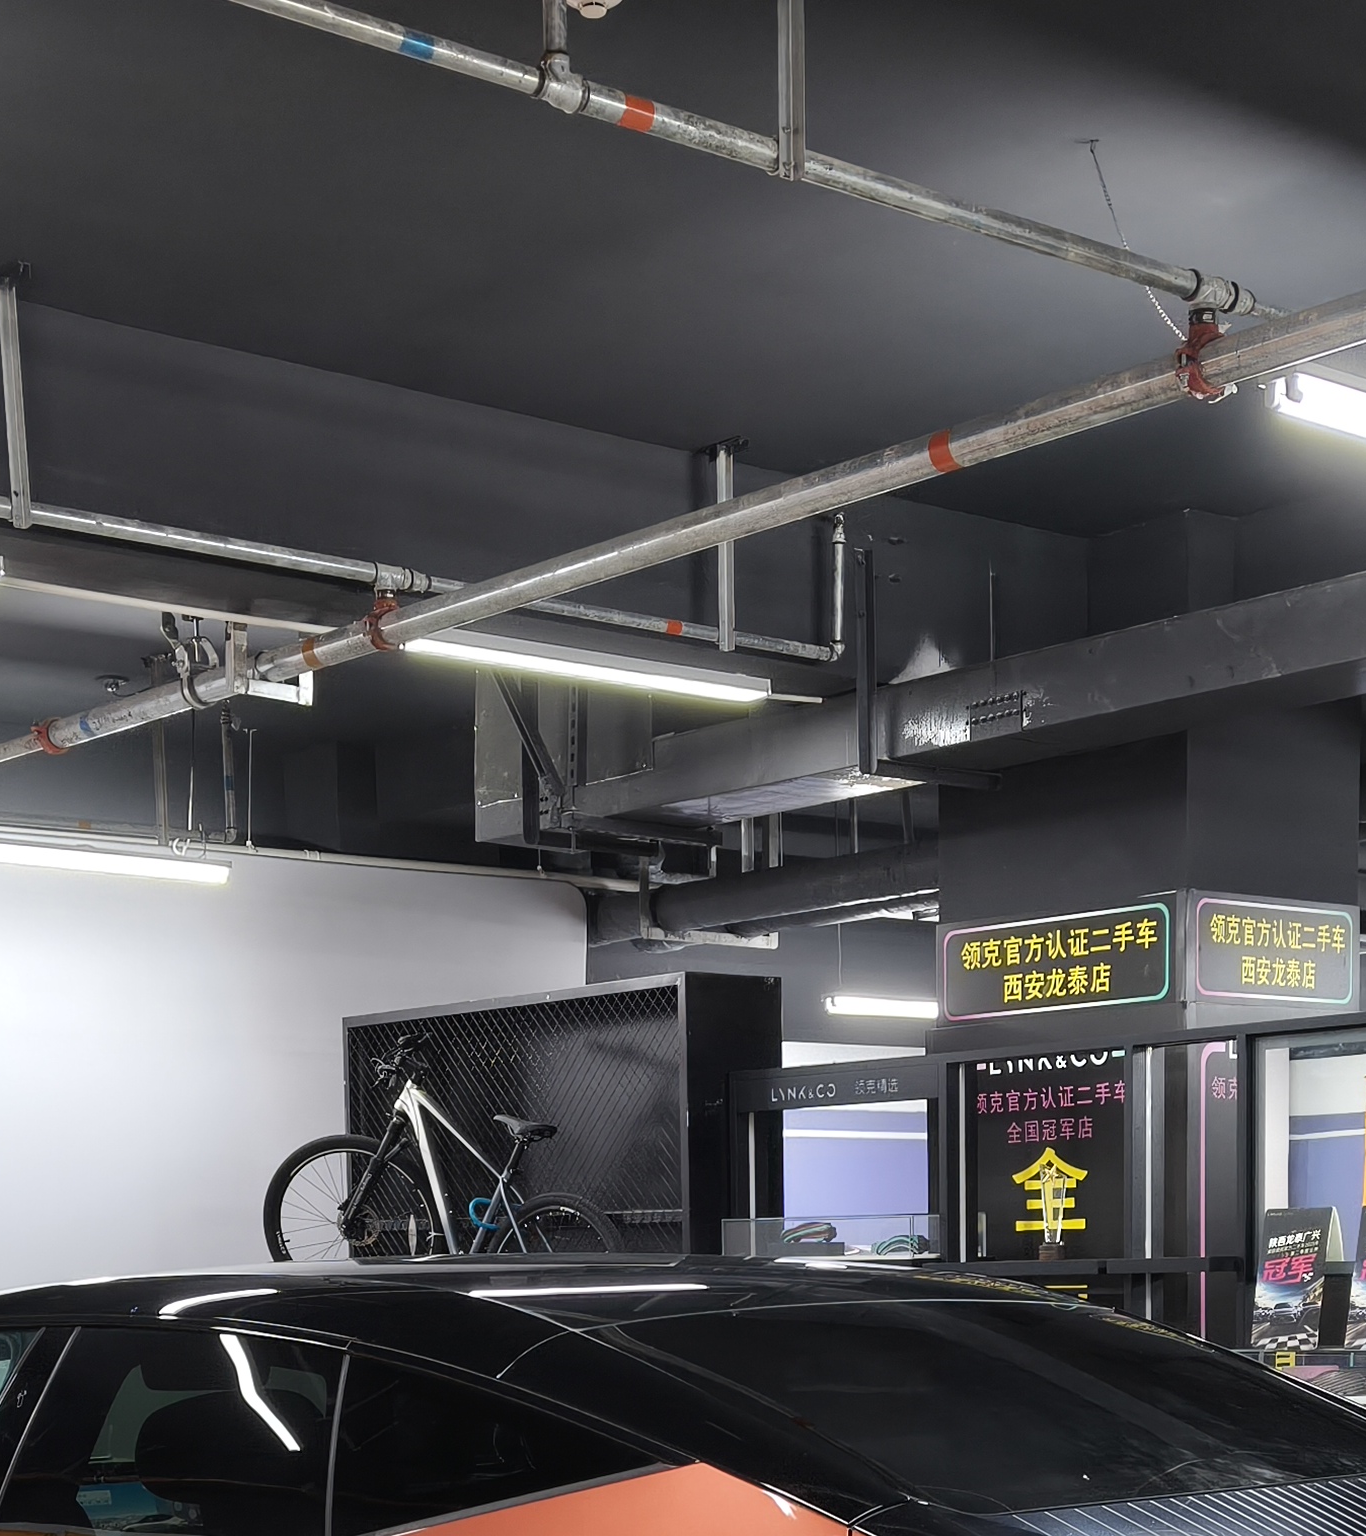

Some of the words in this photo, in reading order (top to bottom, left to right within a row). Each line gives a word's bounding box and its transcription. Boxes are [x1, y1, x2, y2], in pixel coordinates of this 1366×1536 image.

[961, 918, 1158, 970] 领克官方认证二手车
[1210, 913, 1346, 953] 领克官方认证二手车
[1004, 962, 1112, 1003] 西安龙泰店
[1241, 956, 1316, 989] 西安龙泰店
[1006, 1116, 1093, 1144] 全国冠军店
[1268, 1229, 1322, 1249] 陕西龙泰广兴
[1260, 1253, 1318, 1284] 冠军
